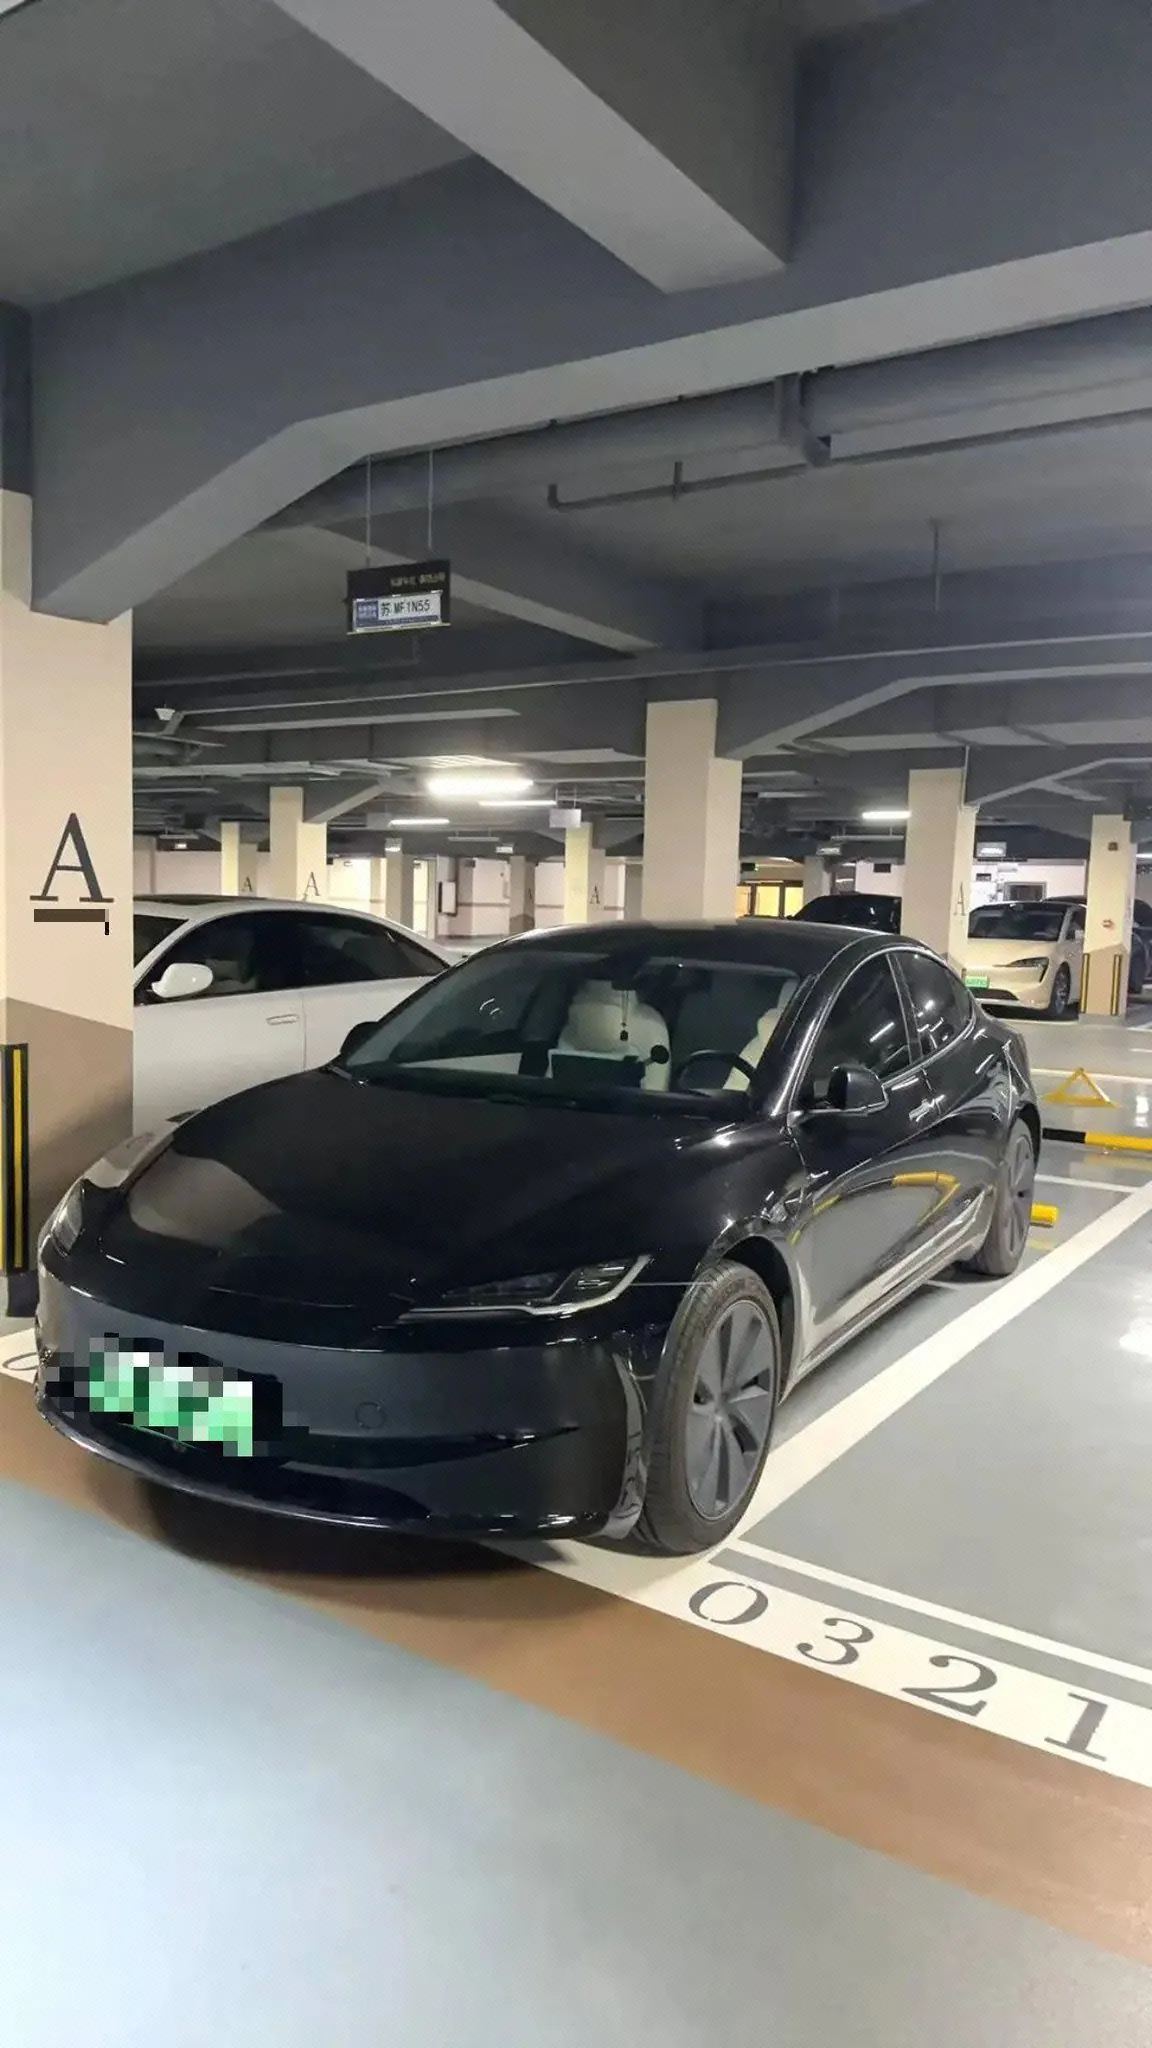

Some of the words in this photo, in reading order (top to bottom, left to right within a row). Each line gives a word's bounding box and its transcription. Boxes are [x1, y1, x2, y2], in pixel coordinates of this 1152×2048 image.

[29, 812, 115, 903] A
[241, 877, 253, 892] A
[302, 872, 320, 898] A
[589, 886, 600, 904] A
[954, 882, 966, 916] A
[688, 1580, 1109, 1762] 0321
